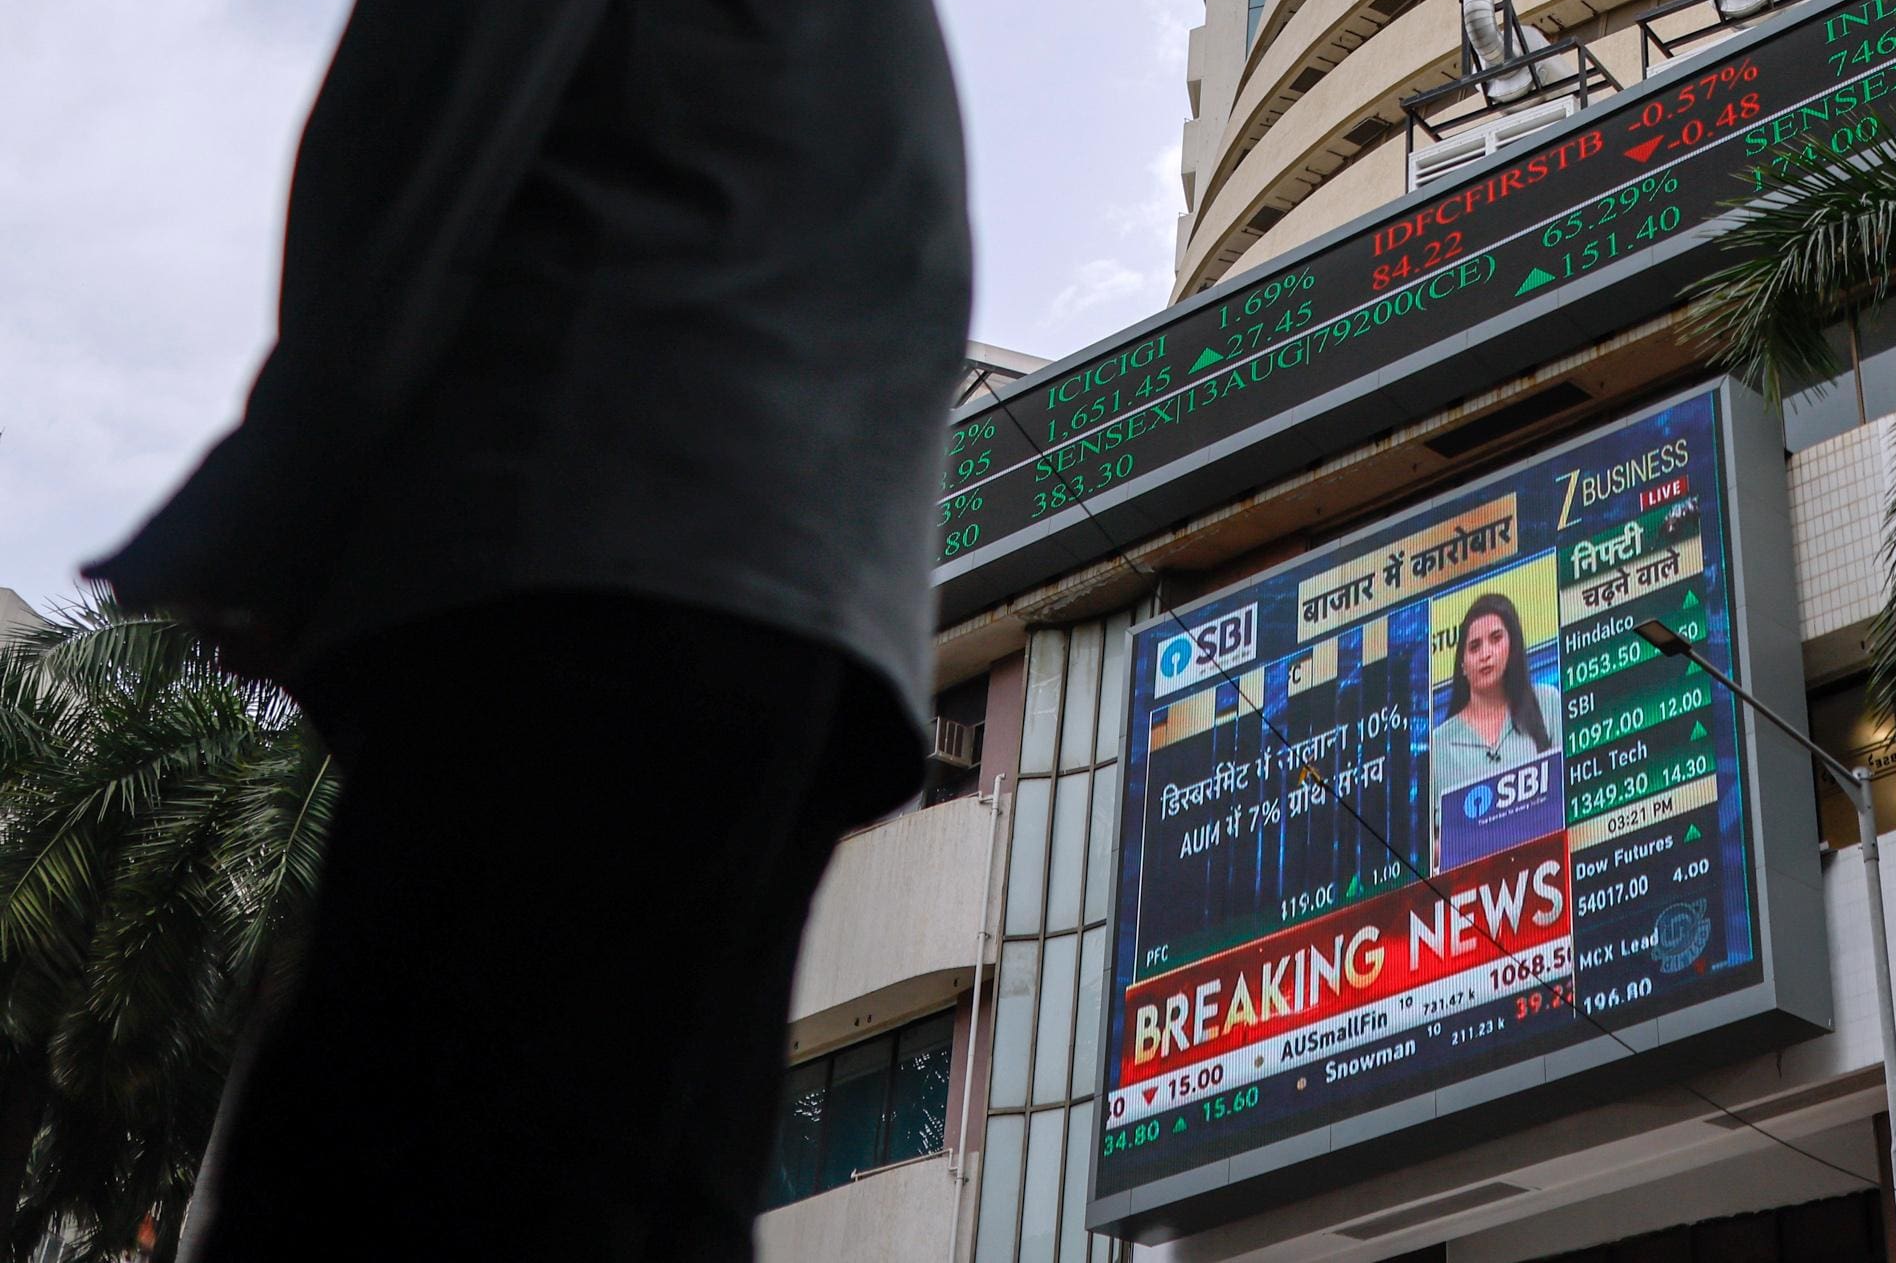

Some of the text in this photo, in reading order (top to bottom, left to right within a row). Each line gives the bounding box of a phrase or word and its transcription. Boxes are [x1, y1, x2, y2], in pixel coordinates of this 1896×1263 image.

[1372, 58, 1758, 258] IDFCFIRSTB -0.57%
[1373, 92, 1761, 292] 84.22 -0.48
[1542, 169, 1679, 249] 65.29%
[1561, 206, 1681, 279] 151.40
[1047, 335, 1169, 411] ICICIGI
[1217, 266, 1315, 330] 1.69%
[1048, 367, 1172, 443] 1,651.45
[1225, 300, 1313, 360] 27.45
[1031, 454, 1134, 518] 383.30
[1582, 439, 1689, 507] BUSINESS
[1648, 481, 1681, 506] LIVE
[1302, 515, 1514, 624] बाजार में कारोबार
[1571, 520, 1643, 580] निफ्टी
[1582, 549, 1682, 609] चढ़ने वाले
[1196, 609, 1253, 665] SBI
[1566, 616, 1634, 653] Hindalco
[1567, 642, 1641, 686] 1053.50
[1568, 692, 1595, 719] SBI
[1569, 688, 1702, 753] 1097.00 12.00
[1496, 760, 1549, 808] SBI
[1570, 741, 1647, 785] HCL Tech
[1571, 756, 1707, 818] 1349.30 14.30
[1180, 820, 1220, 859] AUM
[1248, 798, 1281, 833] 7%
[1608, 797, 1674, 834] 03:21 PM
[1576, 834, 1674, 881] Dow Futures
[1578, 858, 1710, 917] 54017.00 4.00
[1146, 944, 1169, 969] PFC
[1373, 861, 1401, 886] 1.00
[1135, 926, 1385, 1066] BREAKING
[1409, 860, 1563, 972] NEWS
[1579, 927, 1659, 972] MCX Lead
[1583, 977, 1653, 1016] 196.80
[1109, 1096, 1126, 1119] 0
[1169, 1064, 1224, 1100] 15.00
[1281, 1011, 1388, 1063] AUSmallFin
[1400, 996, 1413, 1011] 10
[1468, 986, 1476, 1001] k
[1203, 1086, 1259, 1123] 15.60
[1325, 1038, 1416, 1084] Snowman
[1427, 1022, 1442, 1038] 10
[1452, 1018, 1494, 1047] 211.23
[1498, 1016, 1506, 1031] k
